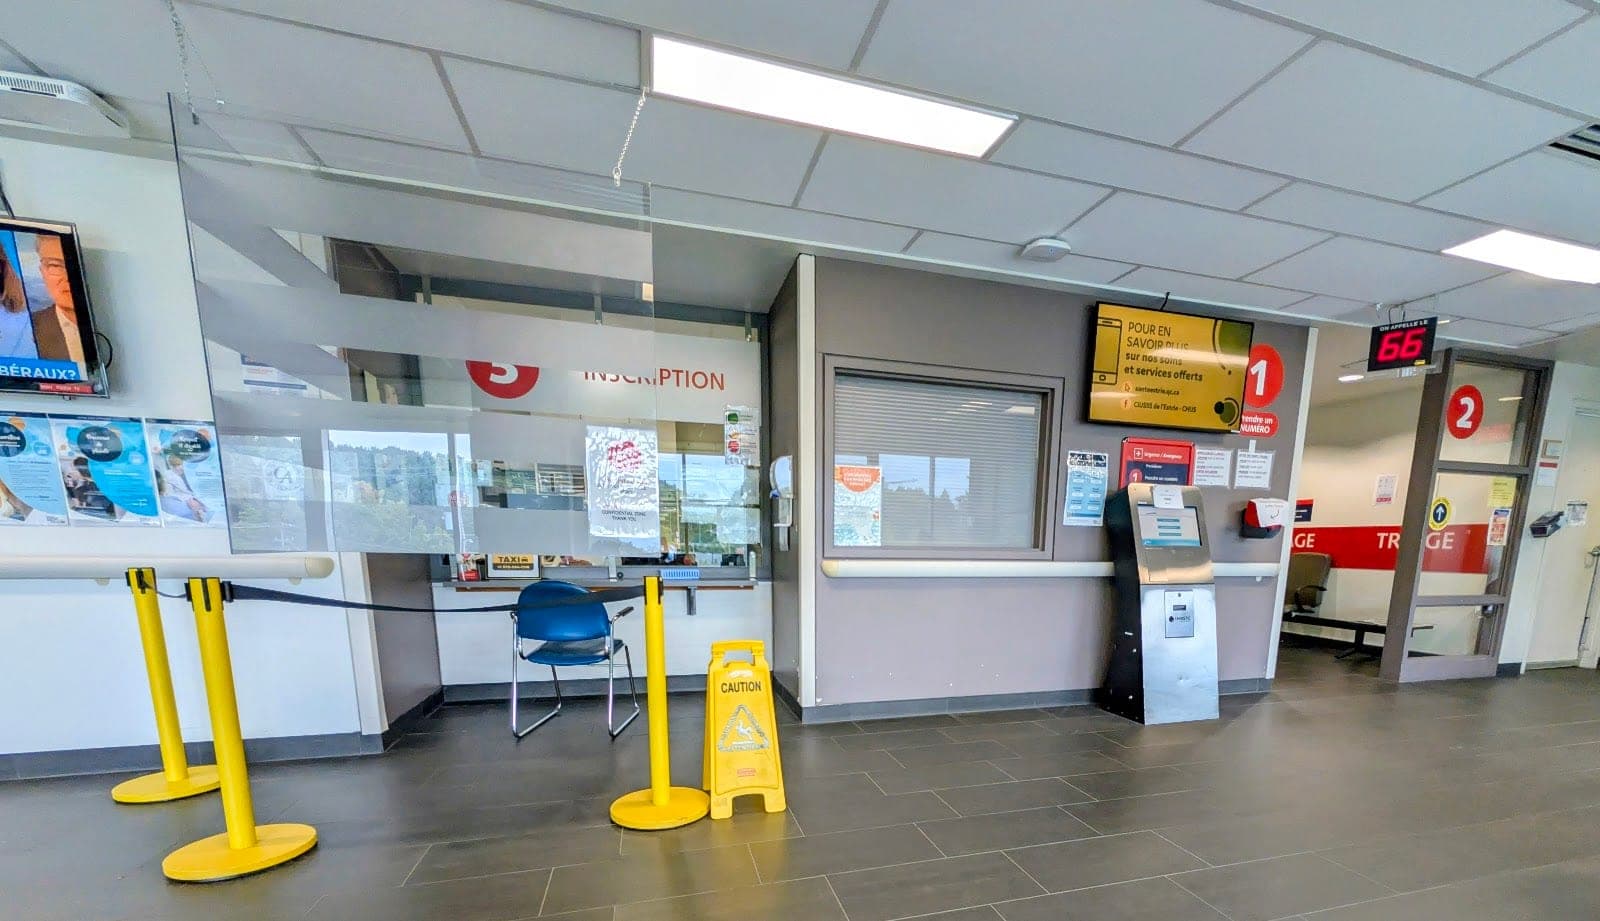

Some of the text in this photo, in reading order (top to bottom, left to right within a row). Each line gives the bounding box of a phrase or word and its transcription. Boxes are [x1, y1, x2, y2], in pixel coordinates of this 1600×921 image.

[1128, 321, 1171, 337] POUR EN
[1126, 336, 1164, 350] SAVOIR
[1377, 327, 1426, 363] 66
[1125, 352, 1183, 366] sur nos soins
[1124, 366, 1203, 381] et services offerts
[1250, 359, 1267, 396] 1
[1456, 396, 1475, 428] 2
[1240, 423, 1271, 434] NUMÉRO
[1291, 533, 1316, 549] GE
[1377, 532, 1455, 549] TRGE
[721, 681, 762, 694] CAUTION
